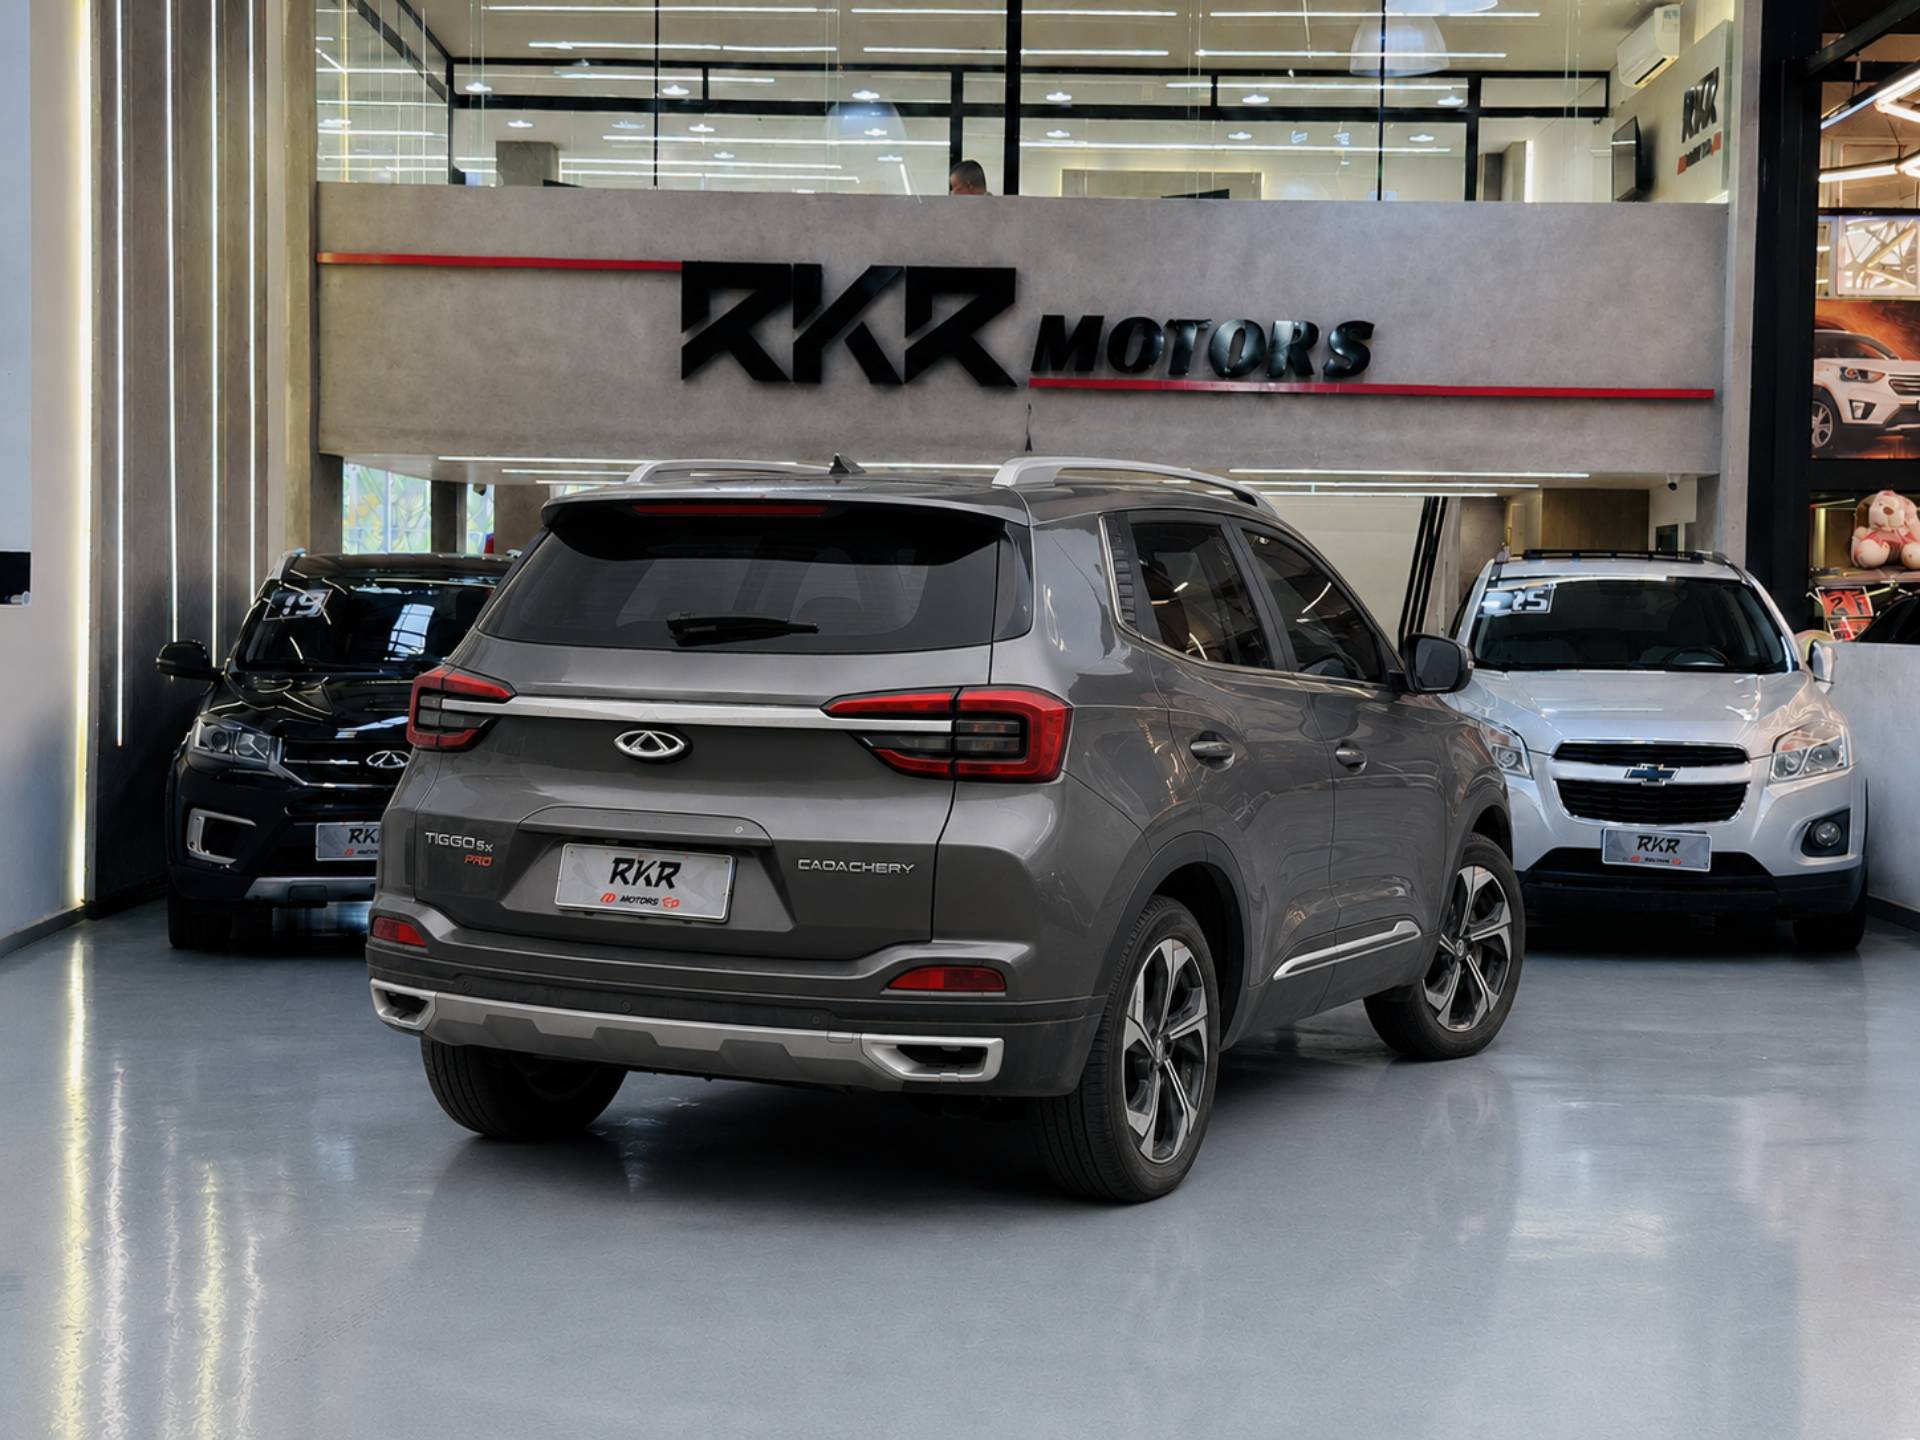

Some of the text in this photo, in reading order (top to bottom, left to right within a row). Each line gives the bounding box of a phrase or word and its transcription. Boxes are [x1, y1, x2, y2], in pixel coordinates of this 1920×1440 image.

[681, 261, 1375, 387] RKR MOTORS
[348, 828, 379, 844] RK
[1636, 835, 1681, 854] RKR
[464, 854, 493, 867] PRO
[609, 857, 682, 889] RKR
[620, 895, 659, 906] MOTORS
